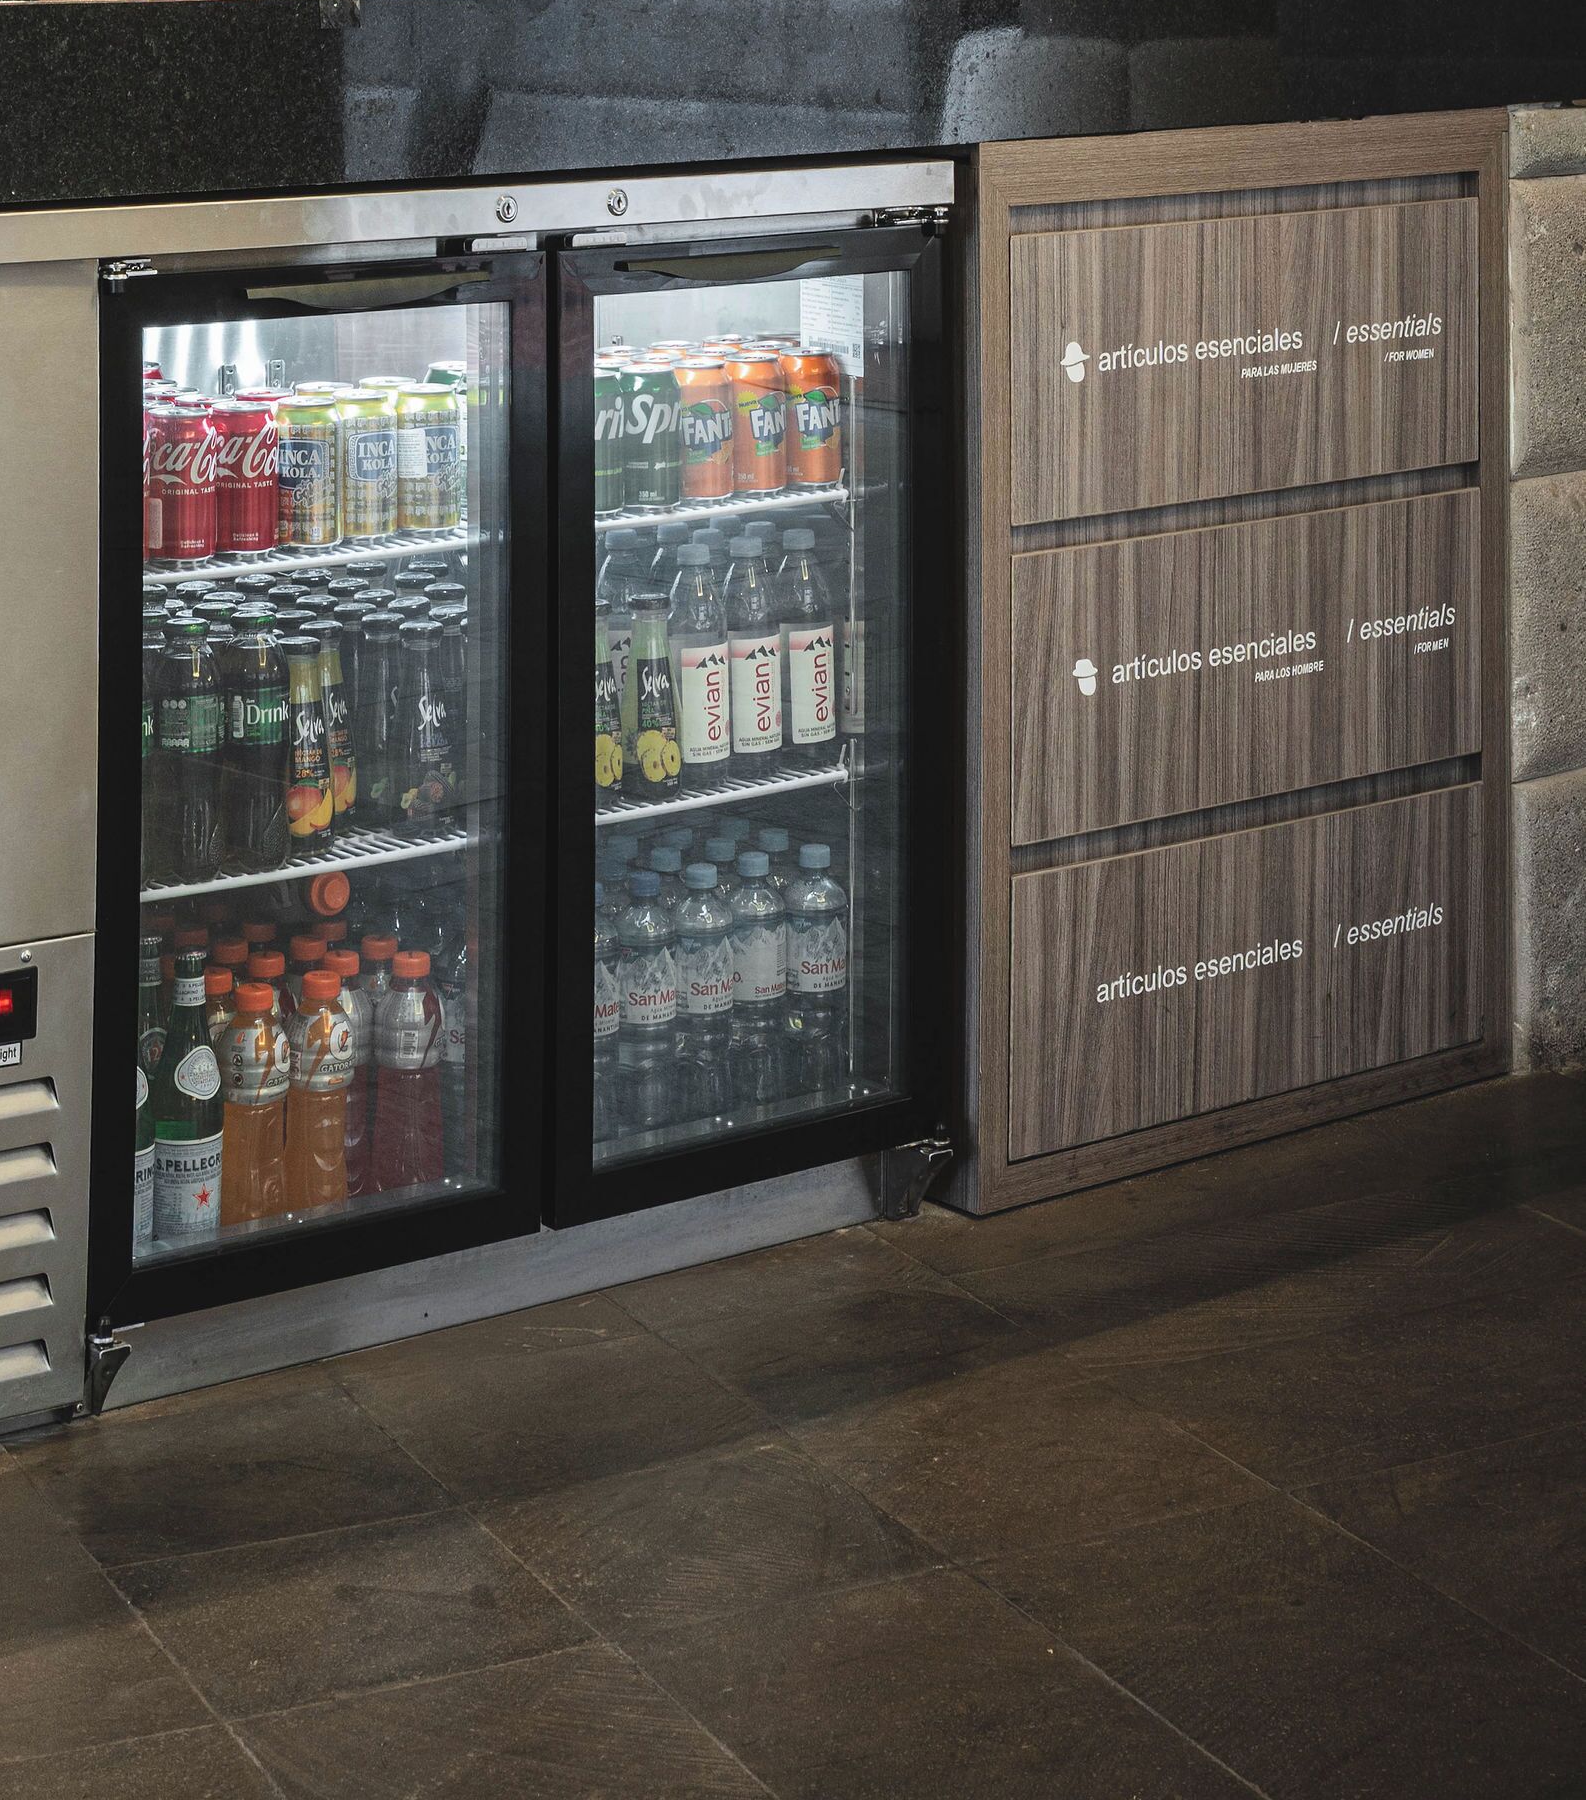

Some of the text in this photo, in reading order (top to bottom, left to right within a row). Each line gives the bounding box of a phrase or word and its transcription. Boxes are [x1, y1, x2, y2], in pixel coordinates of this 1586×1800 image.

[1098, 312, 1443, 373] artículos esenciales essentials
[1405, 348, 1435, 361] WOMEN
[1240, 359, 1317, 379] PARA LAS MUJERES
[357, 439, 395, 458] INCA
[425, 434, 456, 450] NCA
[280, 449, 322, 466] INCA
[253, 480, 273, 488] TASTE
[1112, 602, 1457, 684] artículos esenciales essentials
[1431, 637, 1449, 652] MEN
[1254, 660, 1324, 683] PARA LOS HOMBRE
[641, 666, 670, 701] Selva
[812, 652, 829, 722] evian
[704, 670, 722, 741] evian
[753, 661, 771, 732] evian
[246, 700, 290, 725] Drink
[418, 694, 447, 730] Selva
[294, 711, 325, 746] Selva
[1096, 902, 1444, 1003] artículos esenciales essentials
[801, 961, 829, 975] San
[628, 992, 657, 1007] San
[690, 982, 718, 997] San
